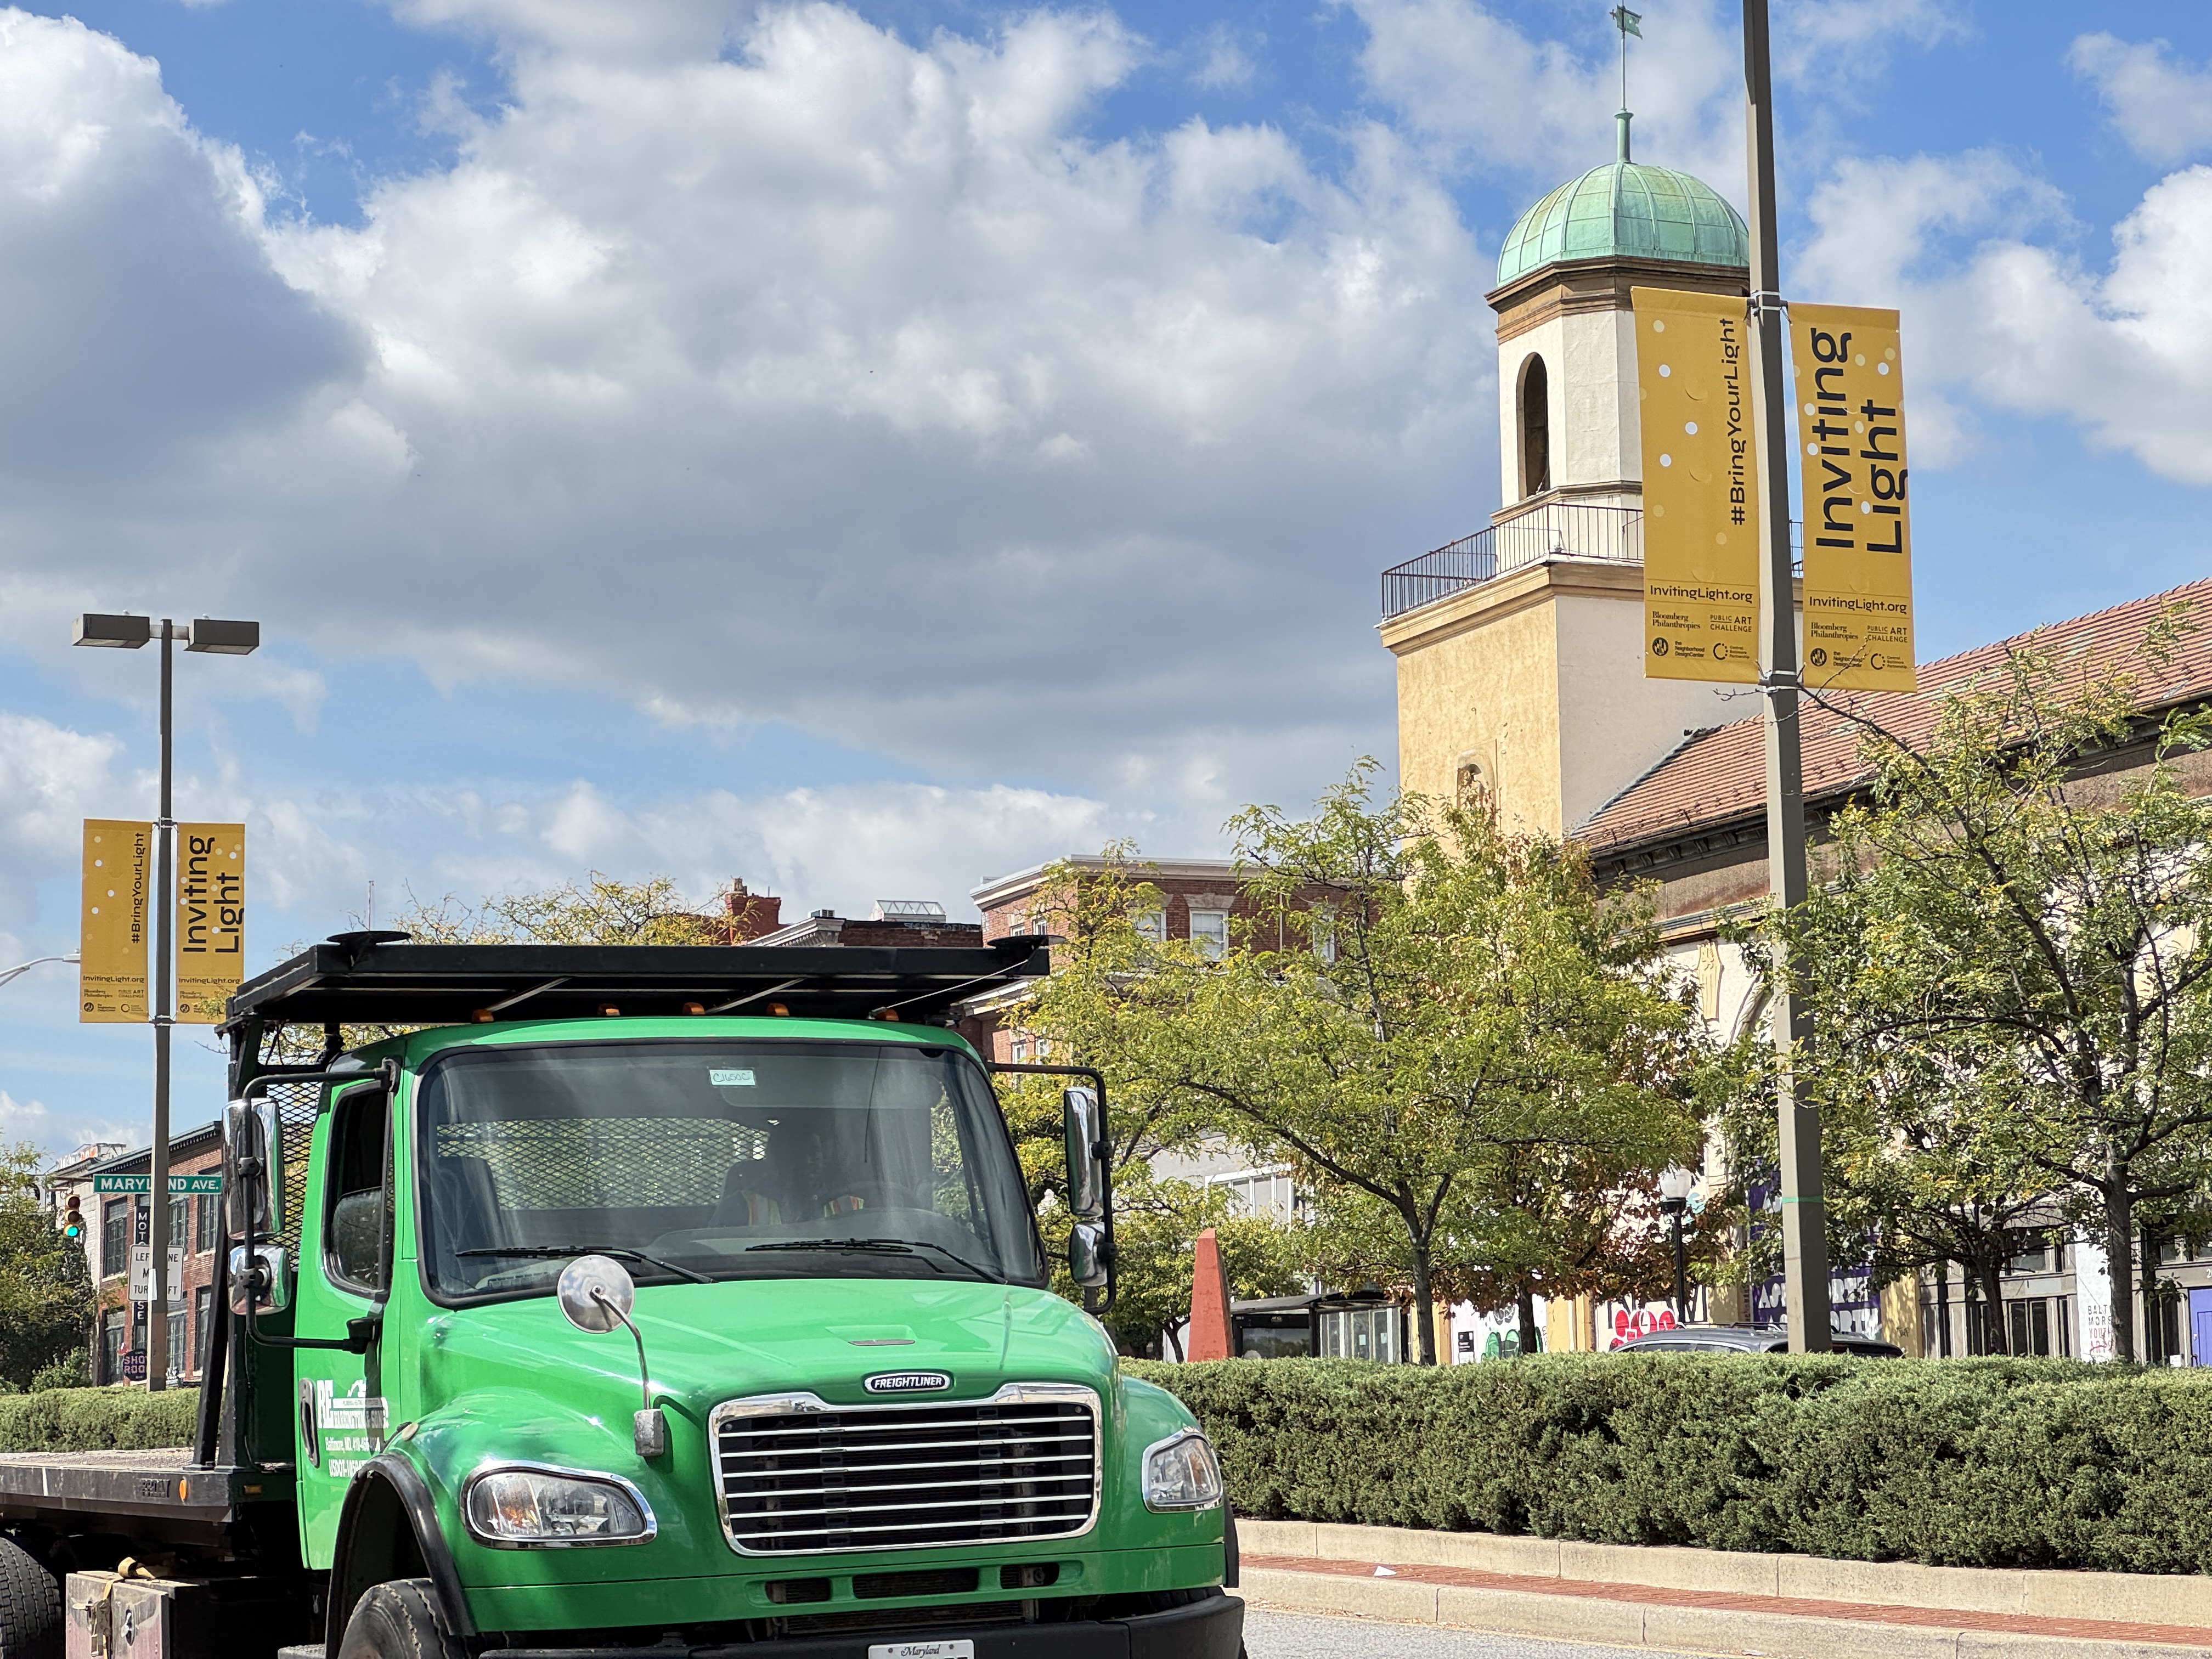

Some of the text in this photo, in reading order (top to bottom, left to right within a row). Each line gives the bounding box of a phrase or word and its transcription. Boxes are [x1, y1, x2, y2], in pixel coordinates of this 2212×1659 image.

[1720, 318, 1746, 526] #BringYourLight
[1810, 327, 1854, 549] Inviting
[1860, 399, 1908, 554] Light
[1650, 585, 1753, 604] InvitingLight.org
[1809, 596, 1908, 615] InvitingLight.org
[1652, 611, 1689, 622] Bloomberg
[1734, 617, 1752, 625] ART
[1652, 619, 1701, 631] Philanthropies
[1710, 624, 1752, 633] CHALLENGE
[1811, 622, 1847, 633] Bloomberg
[1811, 630, 1859, 641] Philanthropies
[1890, 627, 1908, 635] ART
[1867, 634, 1908, 643] CHALLENGE
[131, 832, 146, 944] #BringYourLight
[183, 836, 215, 952] Inviting
[213, 872, 245, 953] Light
[83, 975, 145, 984] InvitingLight.org
[100, 1178, 219, 1190] MARYLND AVE.
[136, 1252, 150, 1262] LEF
[134, 1285, 149, 1294] TUR
[124, 1356, 146, 1365] SHO
[124, 1364, 145, 1374] ROO
[874, 1376, 943, 1389] FREIGHTLINER
[900, 1644, 941, 1658] Maryland
